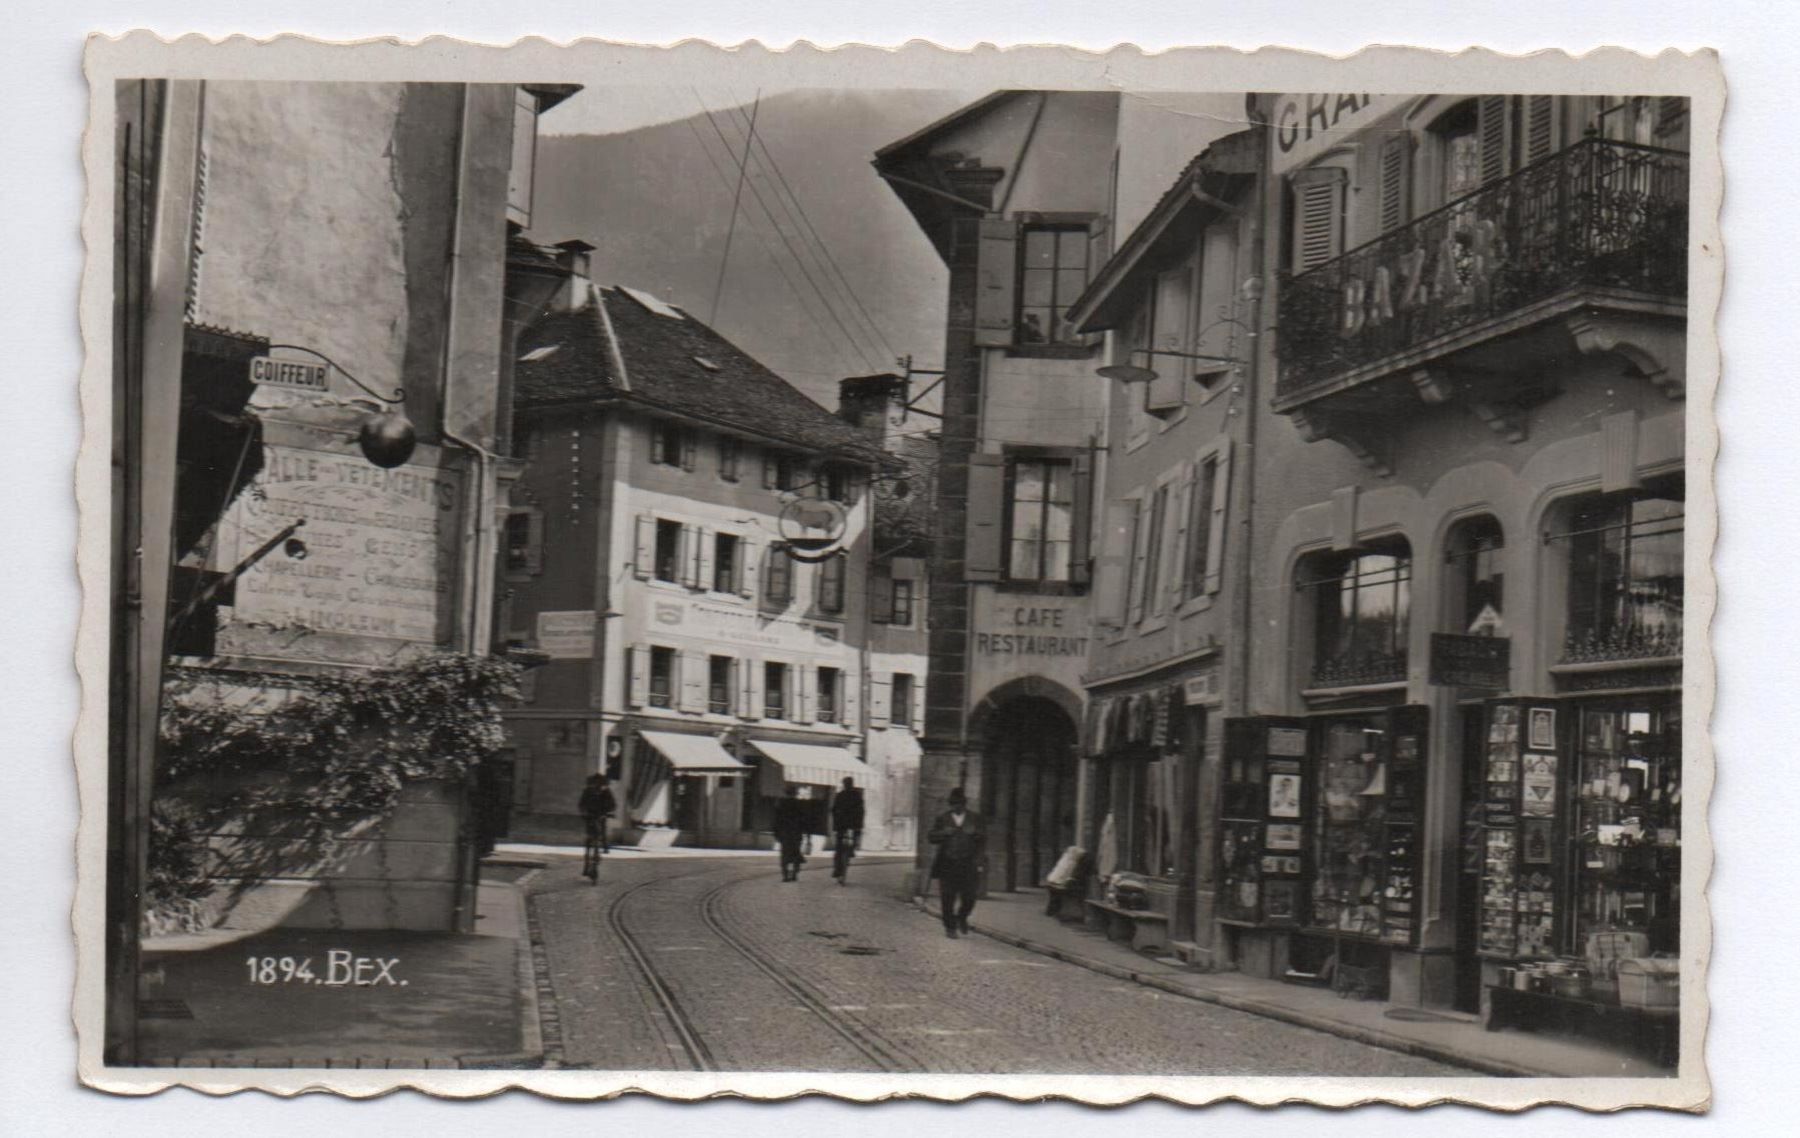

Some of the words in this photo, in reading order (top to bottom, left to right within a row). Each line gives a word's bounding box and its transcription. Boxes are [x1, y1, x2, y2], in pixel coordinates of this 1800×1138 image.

[1279, 92, 1371, 153] GRA
[254, 360, 327, 387] COIFFEUR
[1013, 606, 1064, 628] CAFE
[977, 632, 1090, 658] RESTAURANT
